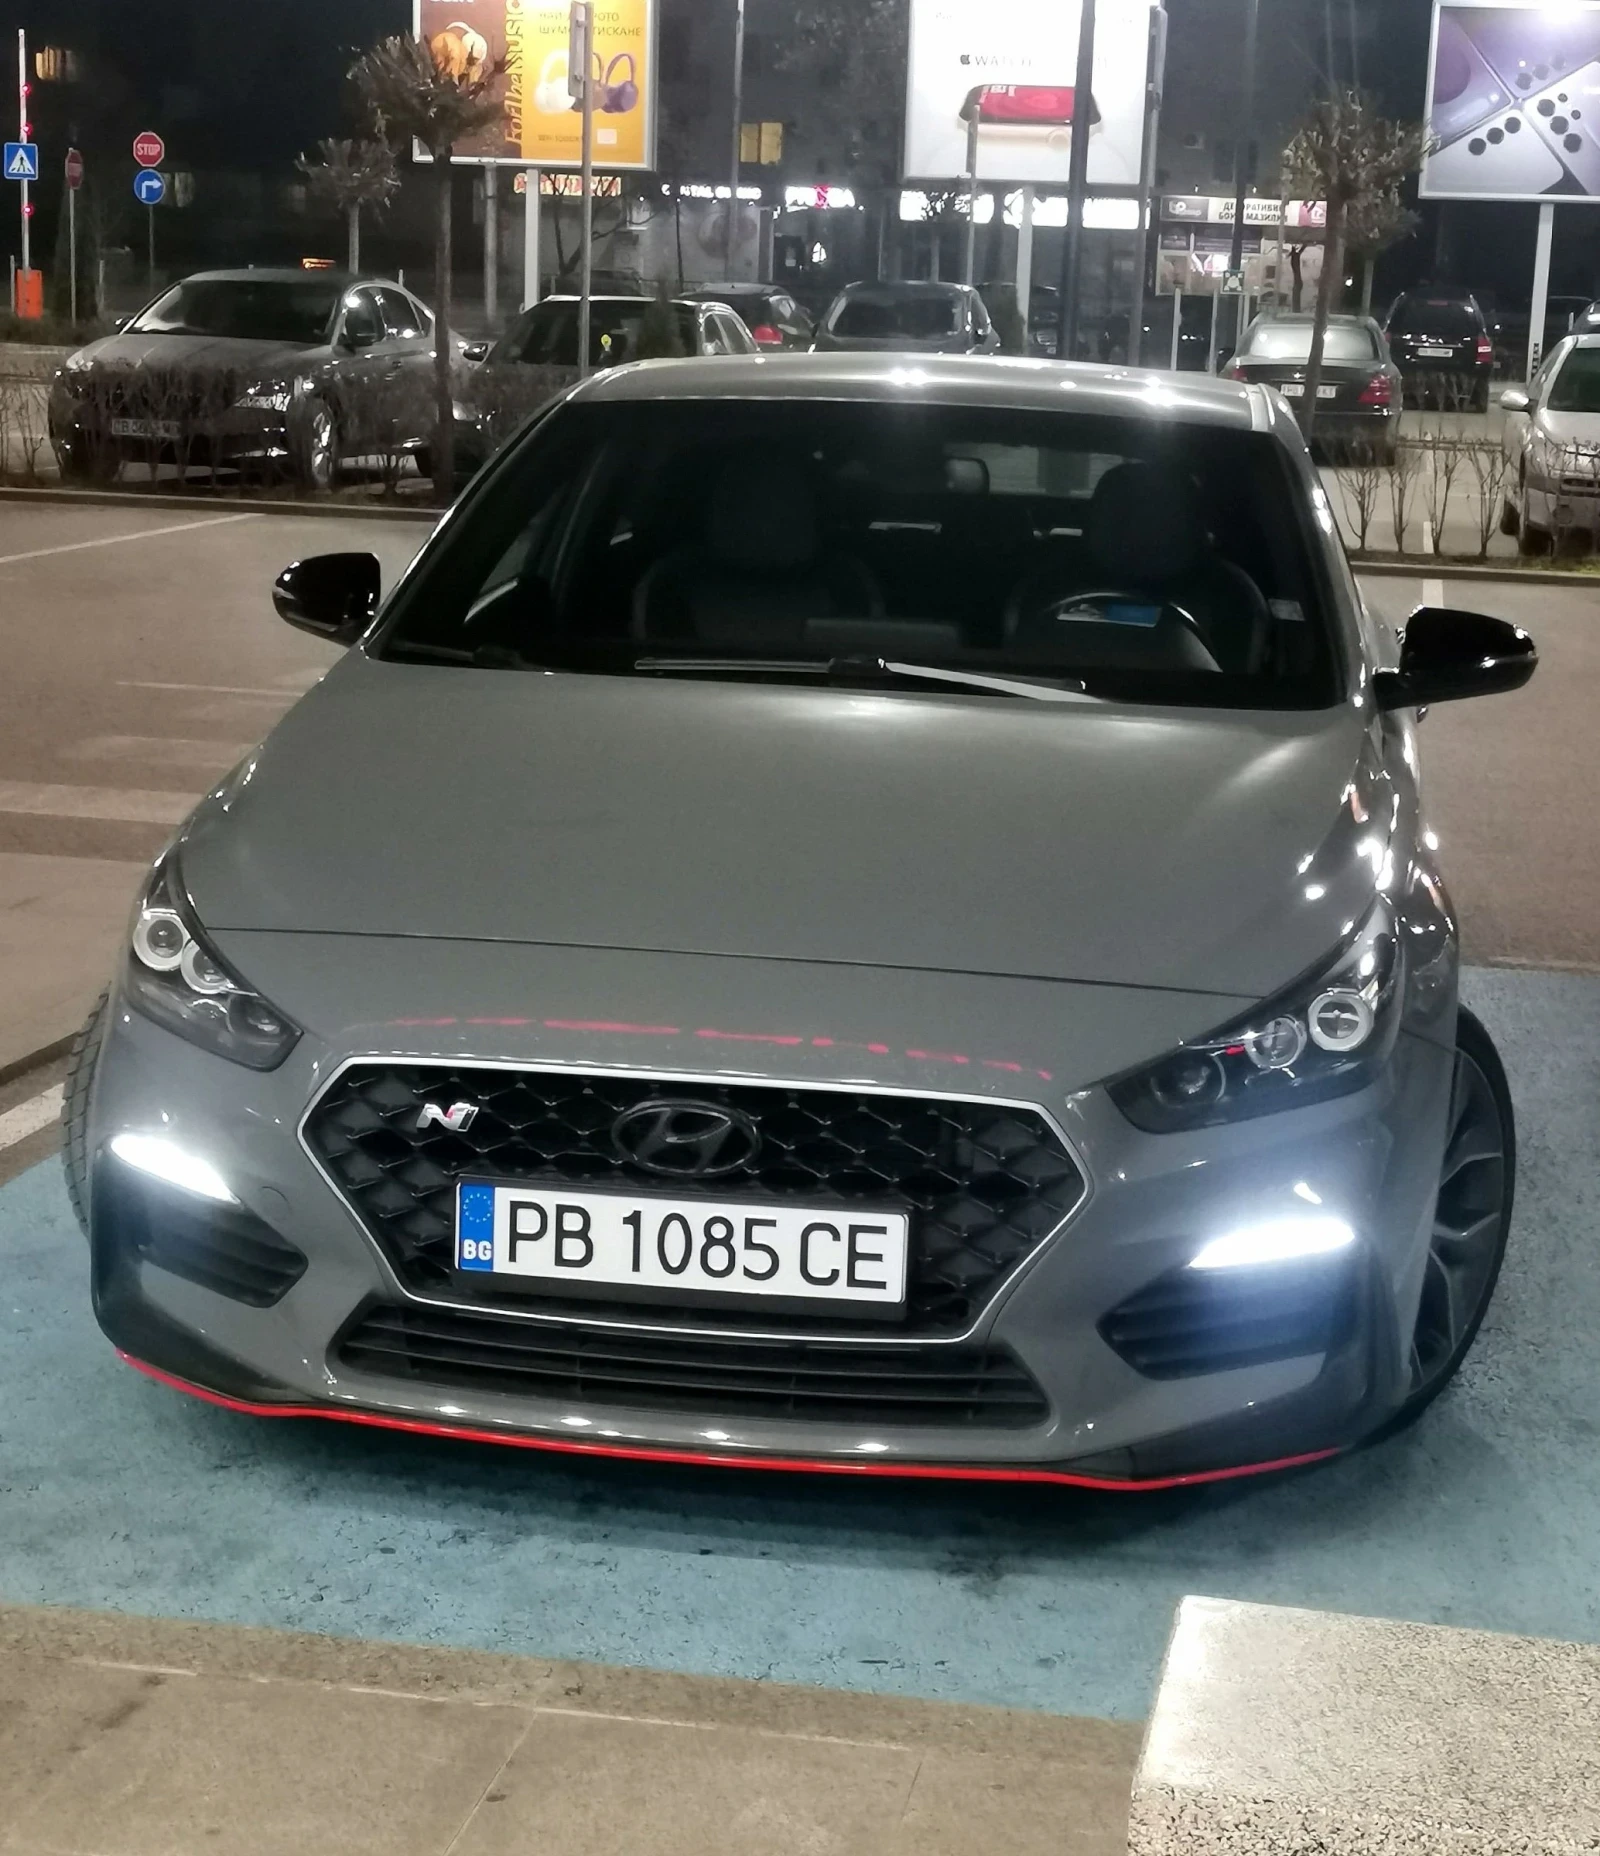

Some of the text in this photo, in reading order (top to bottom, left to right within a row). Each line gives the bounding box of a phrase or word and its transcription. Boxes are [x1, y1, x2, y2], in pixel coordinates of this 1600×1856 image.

[137, 143, 161, 156] STOP
[462, 1238, 492, 1261] BG
[507, 1200, 888, 1290] PB 1085 CE
